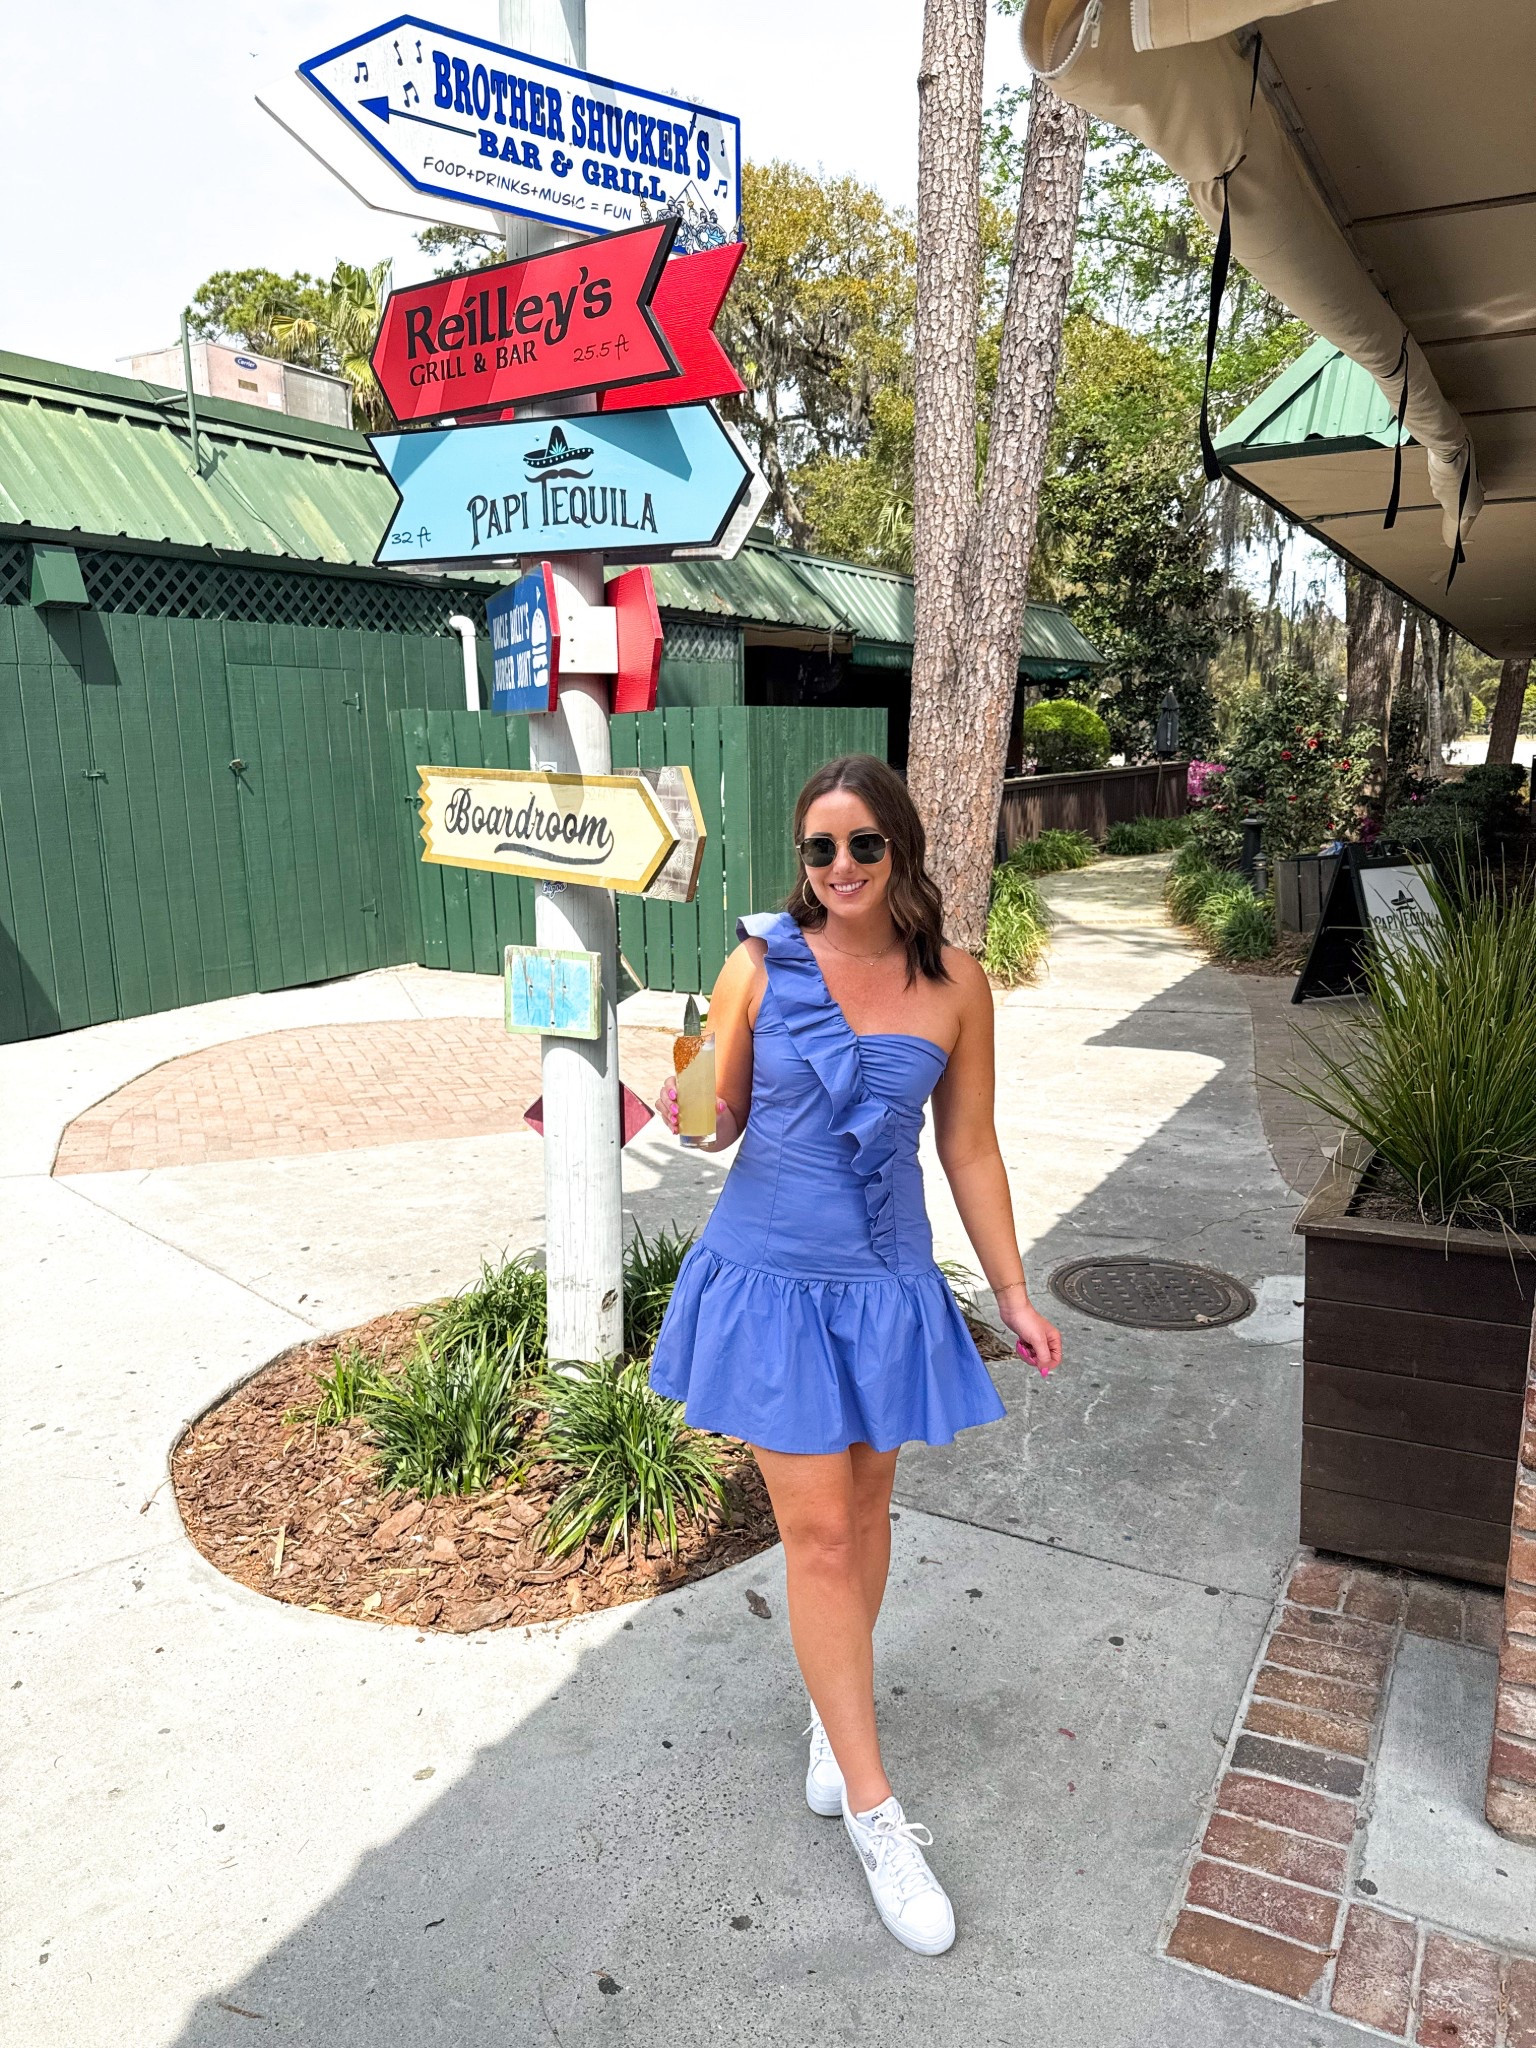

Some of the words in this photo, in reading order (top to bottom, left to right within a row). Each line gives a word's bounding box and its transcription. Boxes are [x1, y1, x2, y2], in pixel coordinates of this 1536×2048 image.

[432, 50, 565, 143] BROTHER
[571, 95, 711, 181] SHUCKER'S
[478, 128, 543, 171] BAR
[551, 150, 573, 178] &
[582, 159, 666, 203] GRILL
[603, 203, 632, 221] FUN
[409, 356, 466, 387] GRILL
[474, 352, 487, 374] &
[496, 340, 537, 369] BAR
[573, 341, 612, 362] 25.5
[615, 334, 629, 360] ft
[391, 531, 414, 545] 32
[416, 526, 432, 548] ft
[466, 492, 529, 550] PAPI
[541, 477, 659, 534] TEQUILA
[444, 787, 615, 851] Boardroom
